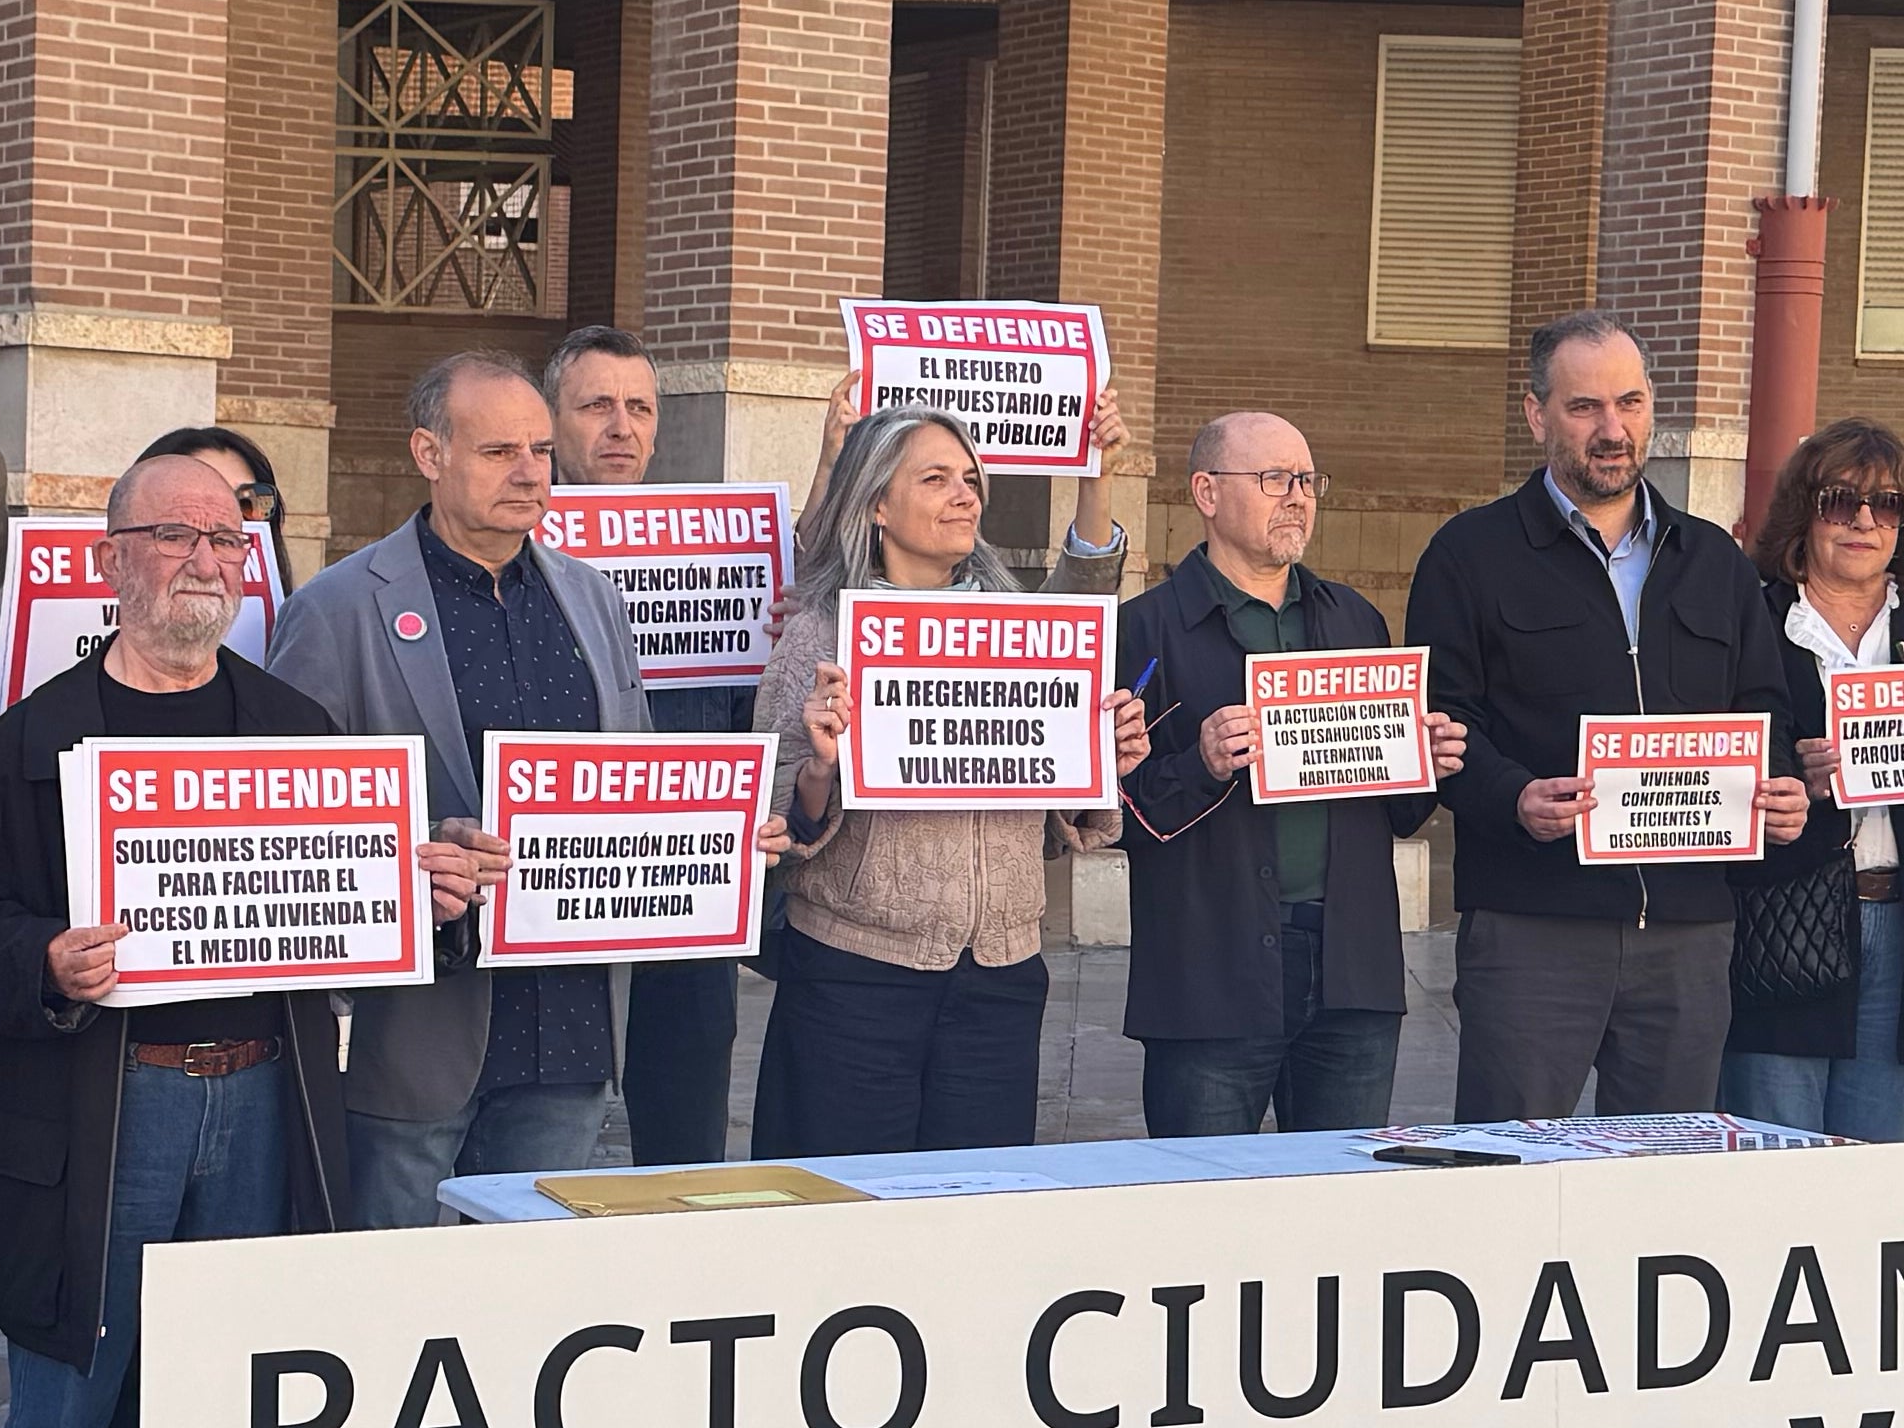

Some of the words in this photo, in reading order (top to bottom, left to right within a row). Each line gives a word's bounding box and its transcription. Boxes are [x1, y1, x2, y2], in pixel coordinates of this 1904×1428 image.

[865, 314, 908, 340] SE
[918, 316, 1087, 350] DEFIENDE
[920, 358, 940, 379] EL
[946, 358, 1042, 384] REFUERZO
[877, 386, 1052, 416] PRESUPUESTARIO
[1058, 395, 1081, 417] EN
[986, 420, 1066, 446] PÚBLICA
[542, 510, 587, 548] SE
[599, 507, 773, 546] DEFIENDE
[29, 546, 71, 585] SE
[717, 565, 767, 590] ANTE
[750, 597, 762, 620] Y
[860, 616, 905, 656] SE
[919, 618, 1096, 659] DEFIENDE
[874, 680, 901, 706] LA
[906, 677, 1079, 707] REGENERACIÓN
[1257, 670, 1288, 699] SE
[1297, 664, 1417, 697] DEFIENDE
[1837, 683, 1865, 711] SE
[1267, 710, 1281, 726] LA
[1285, 704, 1357, 724] ACTUACIÓN
[1360, 702, 1409, 720] CONTRA
[909, 719, 936, 745] DE
[944, 719, 1044, 745] BARRIOS
[1275, 730, 1297, 746] LOS
[1302, 725, 1381, 744] DESAHUCIOS
[1384, 723, 1405, 739] SIN
[1843, 722, 1860, 740] LA
[1303, 746, 1383, 765] ALTERNATIVA
[1591, 733, 1622, 759] SE
[1630, 731, 1758, 758] DEFIENDEN
[508, 759, 558, 803] SE
[572, 760, 755, 802] DEFIENDE
[899, 757, 1056, 784] VULNERABLES
[1299, 766, 1390, 786] HABITACIONAL
[1641, 771, 1710, 786] VIVIENDAS
[109, 769, 158, 813] SE
[174, 767, 401, 811] DEFIENDEN
[1630, 811, 1700, 827] EFICIENTES
[1703, 811, 1712, 825] Y
[518, 837, 540, 859] LA
[546, 832, 662, 859] REGULACIÓN
[667, 834, 694, 856] DEL
[700, 833, 734, 855] USO
[1610, 831, 1732, 848] DESCARBONIZADAS
[519, 864, 621, 890] TURÍSTICO
[626, 867, 638, 887] Y
[642, 863, 731, 887] TEMPORAL
[557, 898, 580, 921] DE
[584, 897, 606, 919] LA
[611, 894, 693, 918] VIVIENDA
